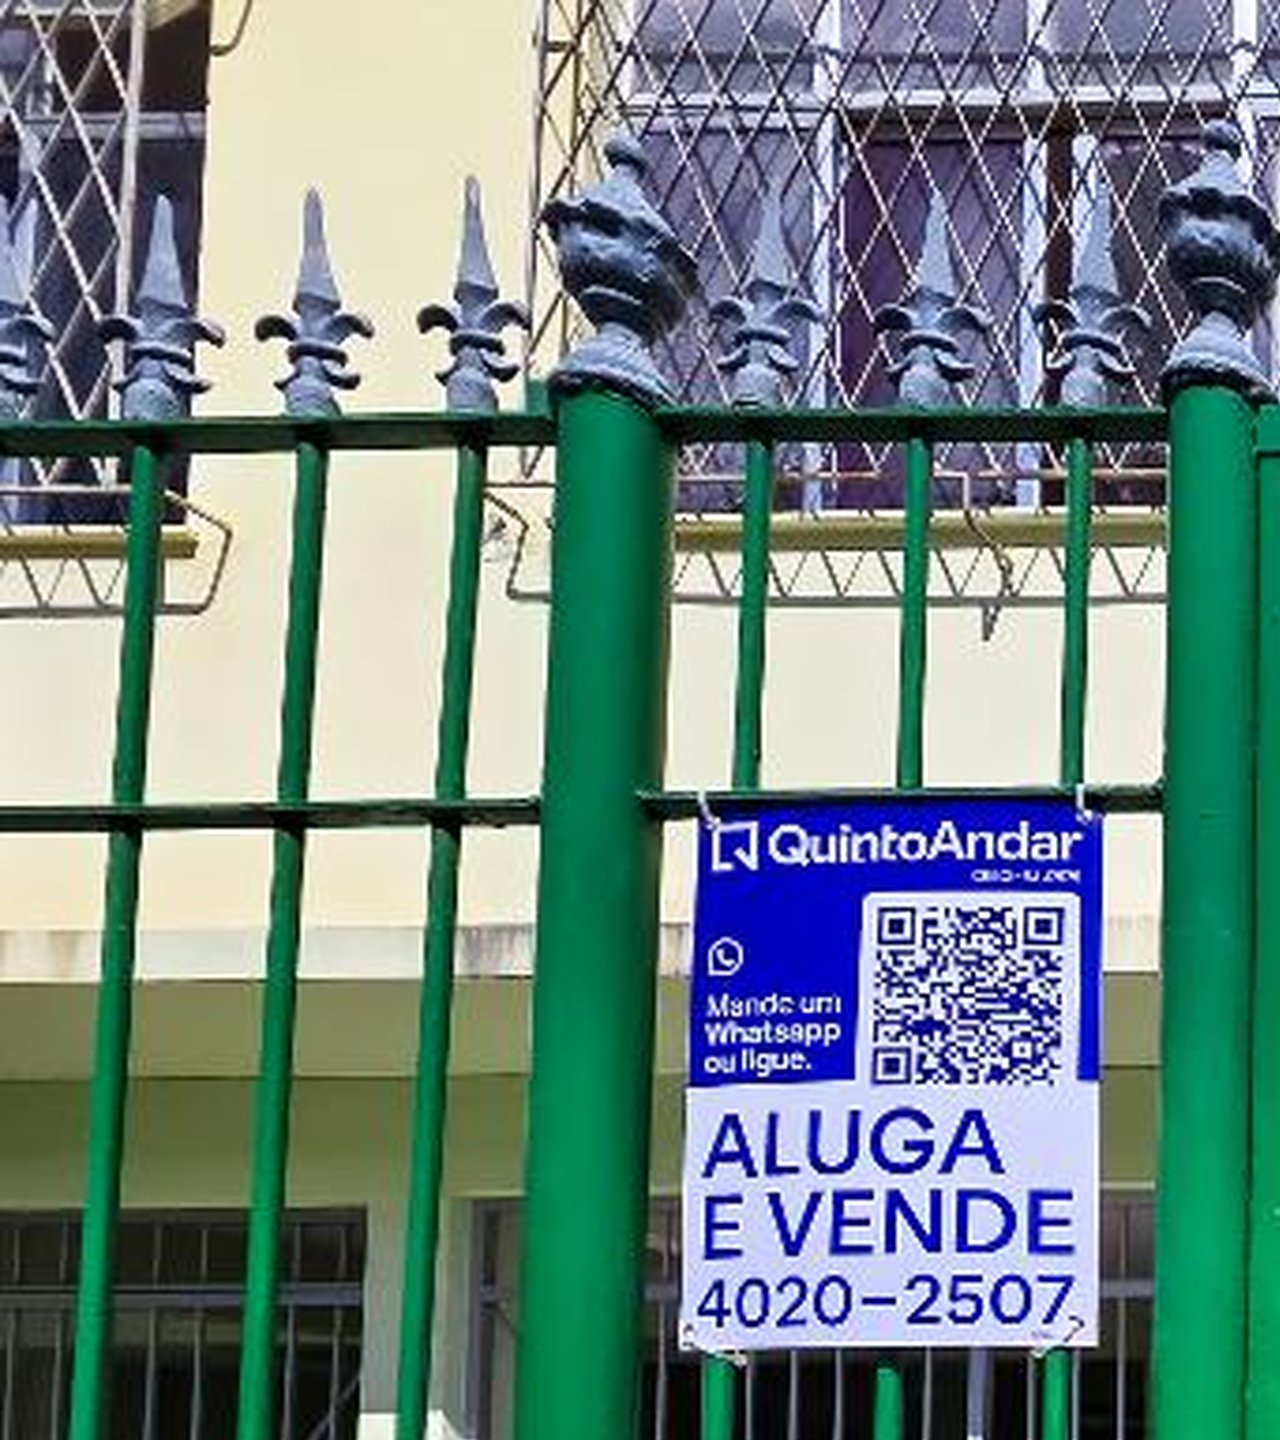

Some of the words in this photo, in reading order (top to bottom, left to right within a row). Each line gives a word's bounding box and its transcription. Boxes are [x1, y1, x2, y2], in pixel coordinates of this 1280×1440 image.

[767, 820, 1084, 867] QuintoAndar
[706, 993, 795, 1017] Mande
[801, 995, 842, 1014] um
[704, 1055, 737, 1074] ou
[741, 1048, 812, 1077] ligue.
[702, 1108, 1006, 1178] ALUGA
[703, 1193, 744, 1260] E
[767, 1189, 1076, 1257] VENDE
[697, 1274, 1076, 1328] 4020-2507
